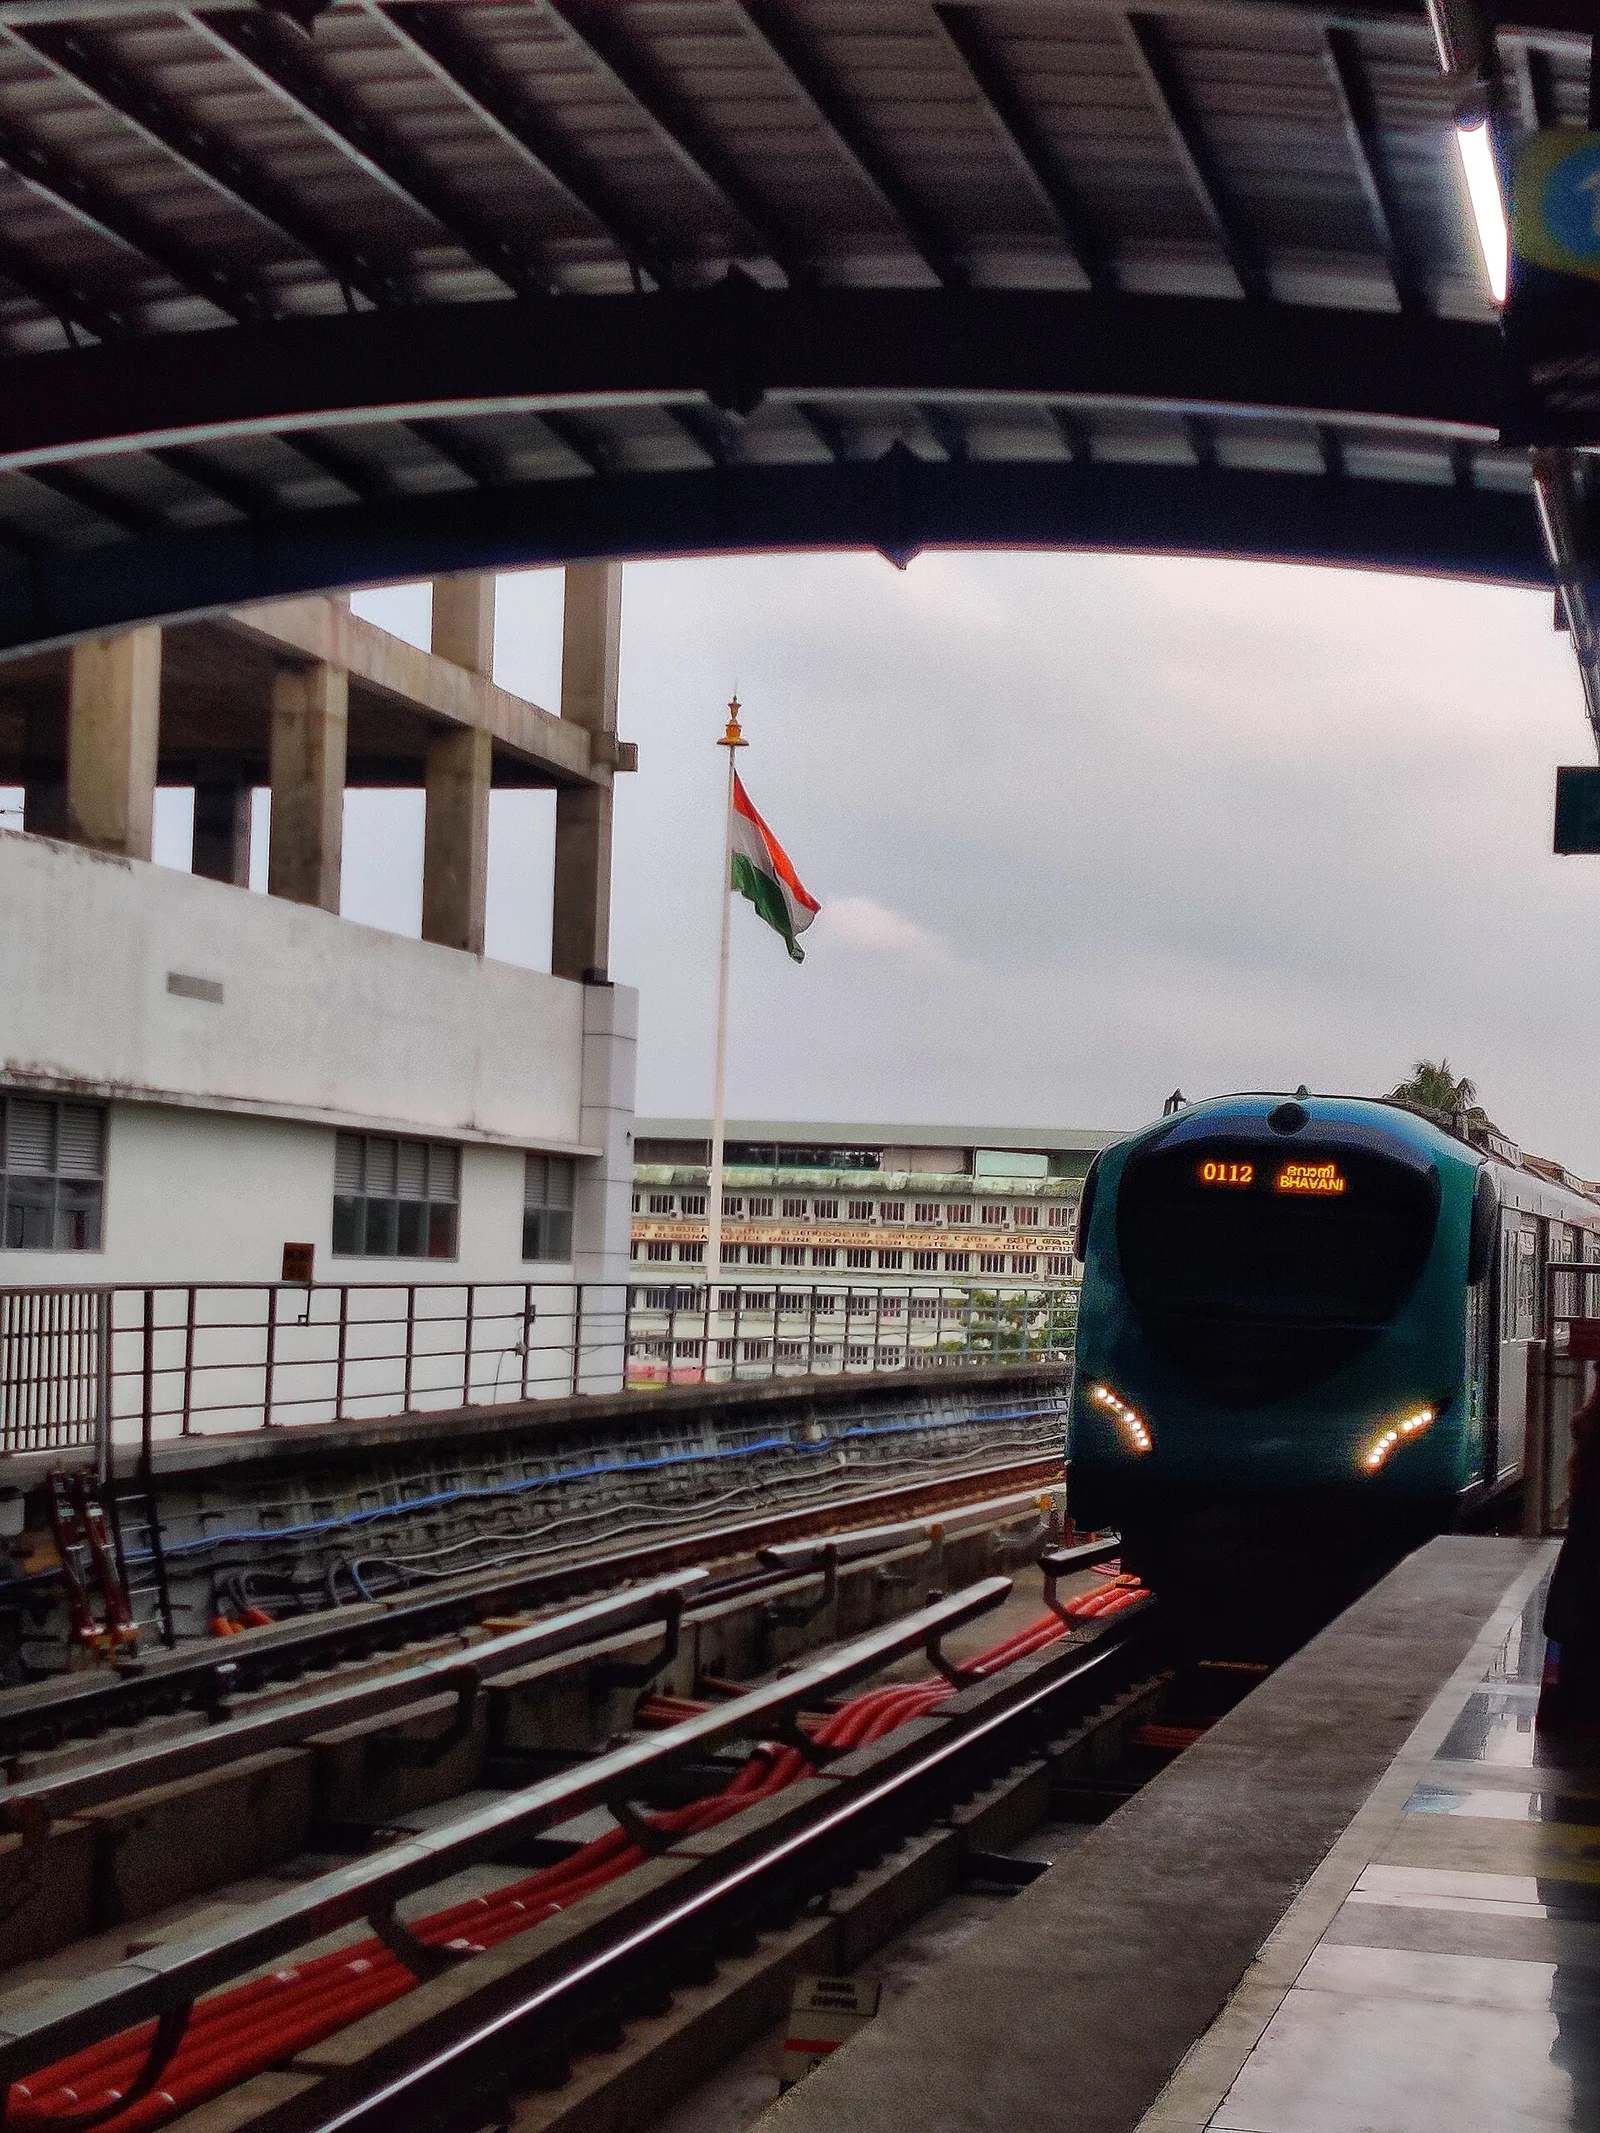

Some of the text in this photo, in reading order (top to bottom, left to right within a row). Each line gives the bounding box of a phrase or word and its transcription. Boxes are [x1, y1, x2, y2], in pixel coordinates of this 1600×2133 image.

[1203, 1163, 1252, 1182] 0112
[1287, 1165, 1335, 1178] ഭവാനി
[1279, 1176, 1344, 1191] BHAVANI
